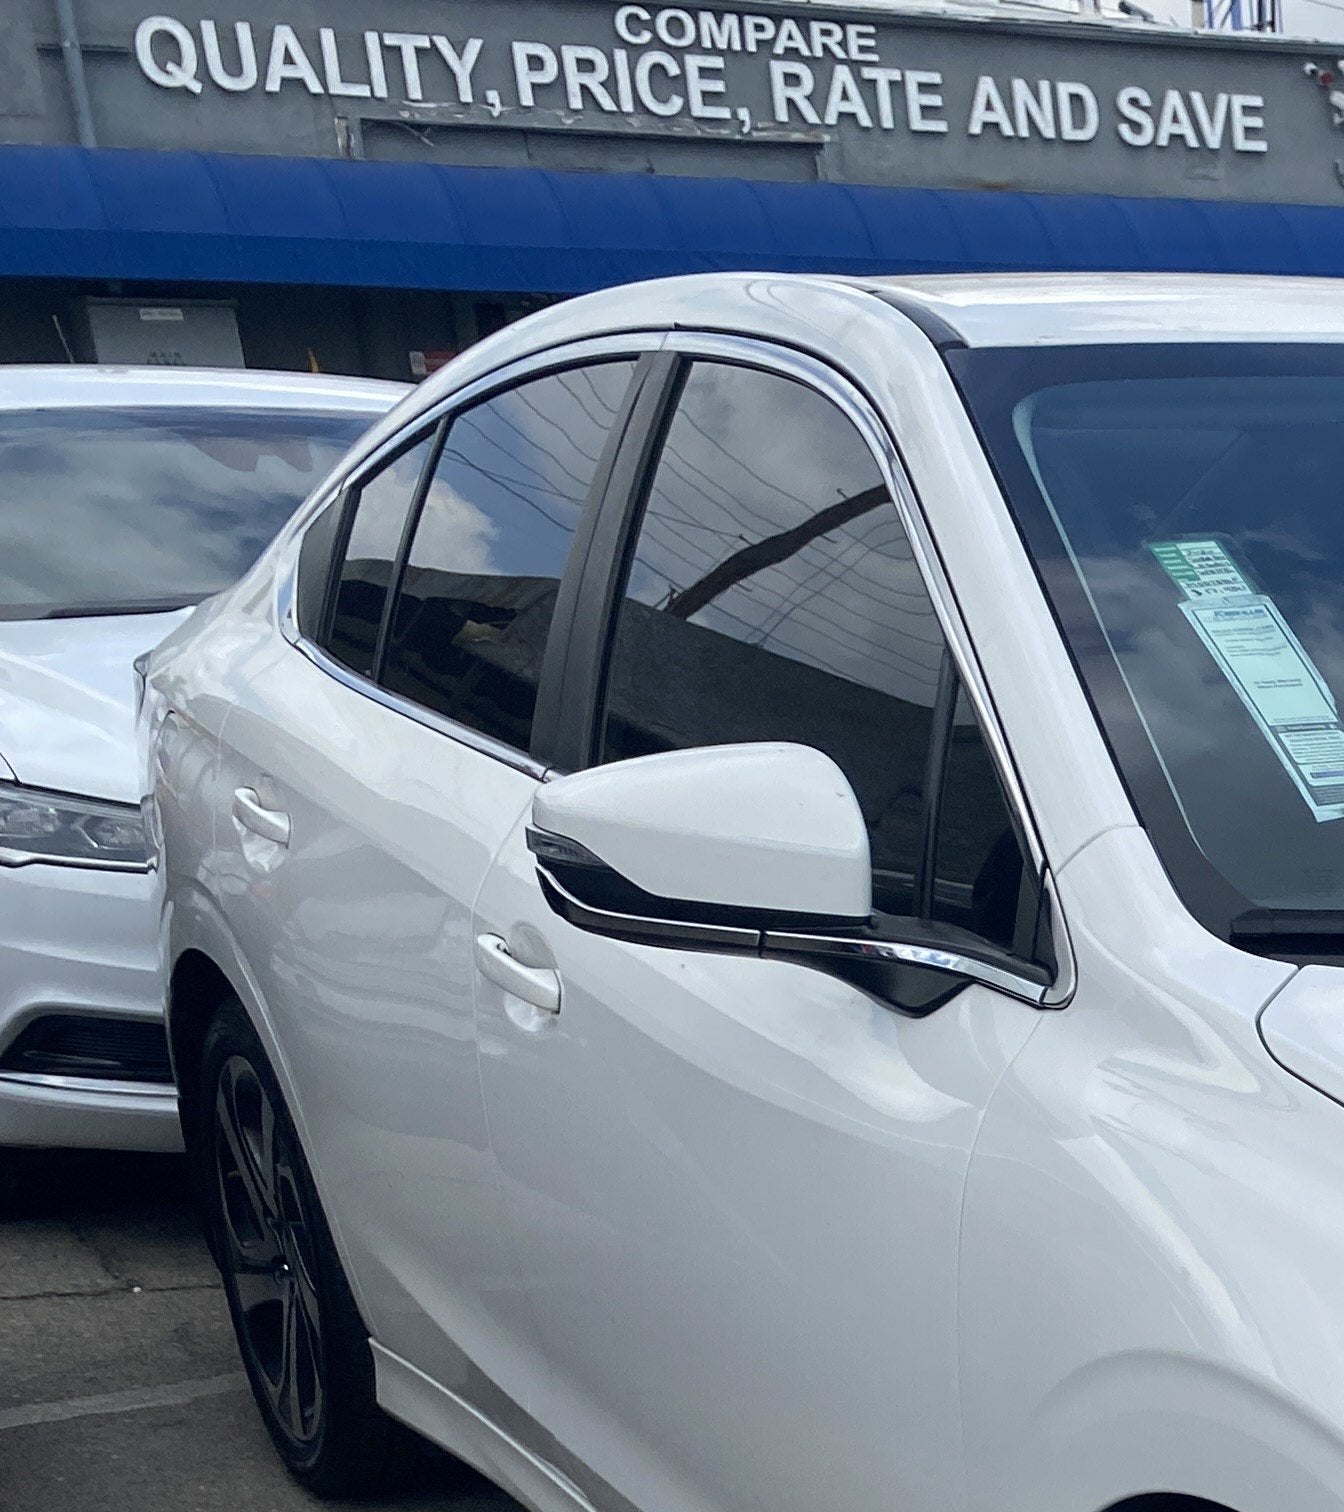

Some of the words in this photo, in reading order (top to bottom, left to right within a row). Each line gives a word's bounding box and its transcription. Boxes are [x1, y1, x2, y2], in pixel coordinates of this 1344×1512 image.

[614, 4, 879, 63] COMPARE
[134, 16, 502, 117] QUALITY,
[511, 40, 753, 134] PRICE,
[770, 59, 948, 134] RATE
[969, 75, 1099, 143] AND
[1116, 86, 1268, 153] SAVE
